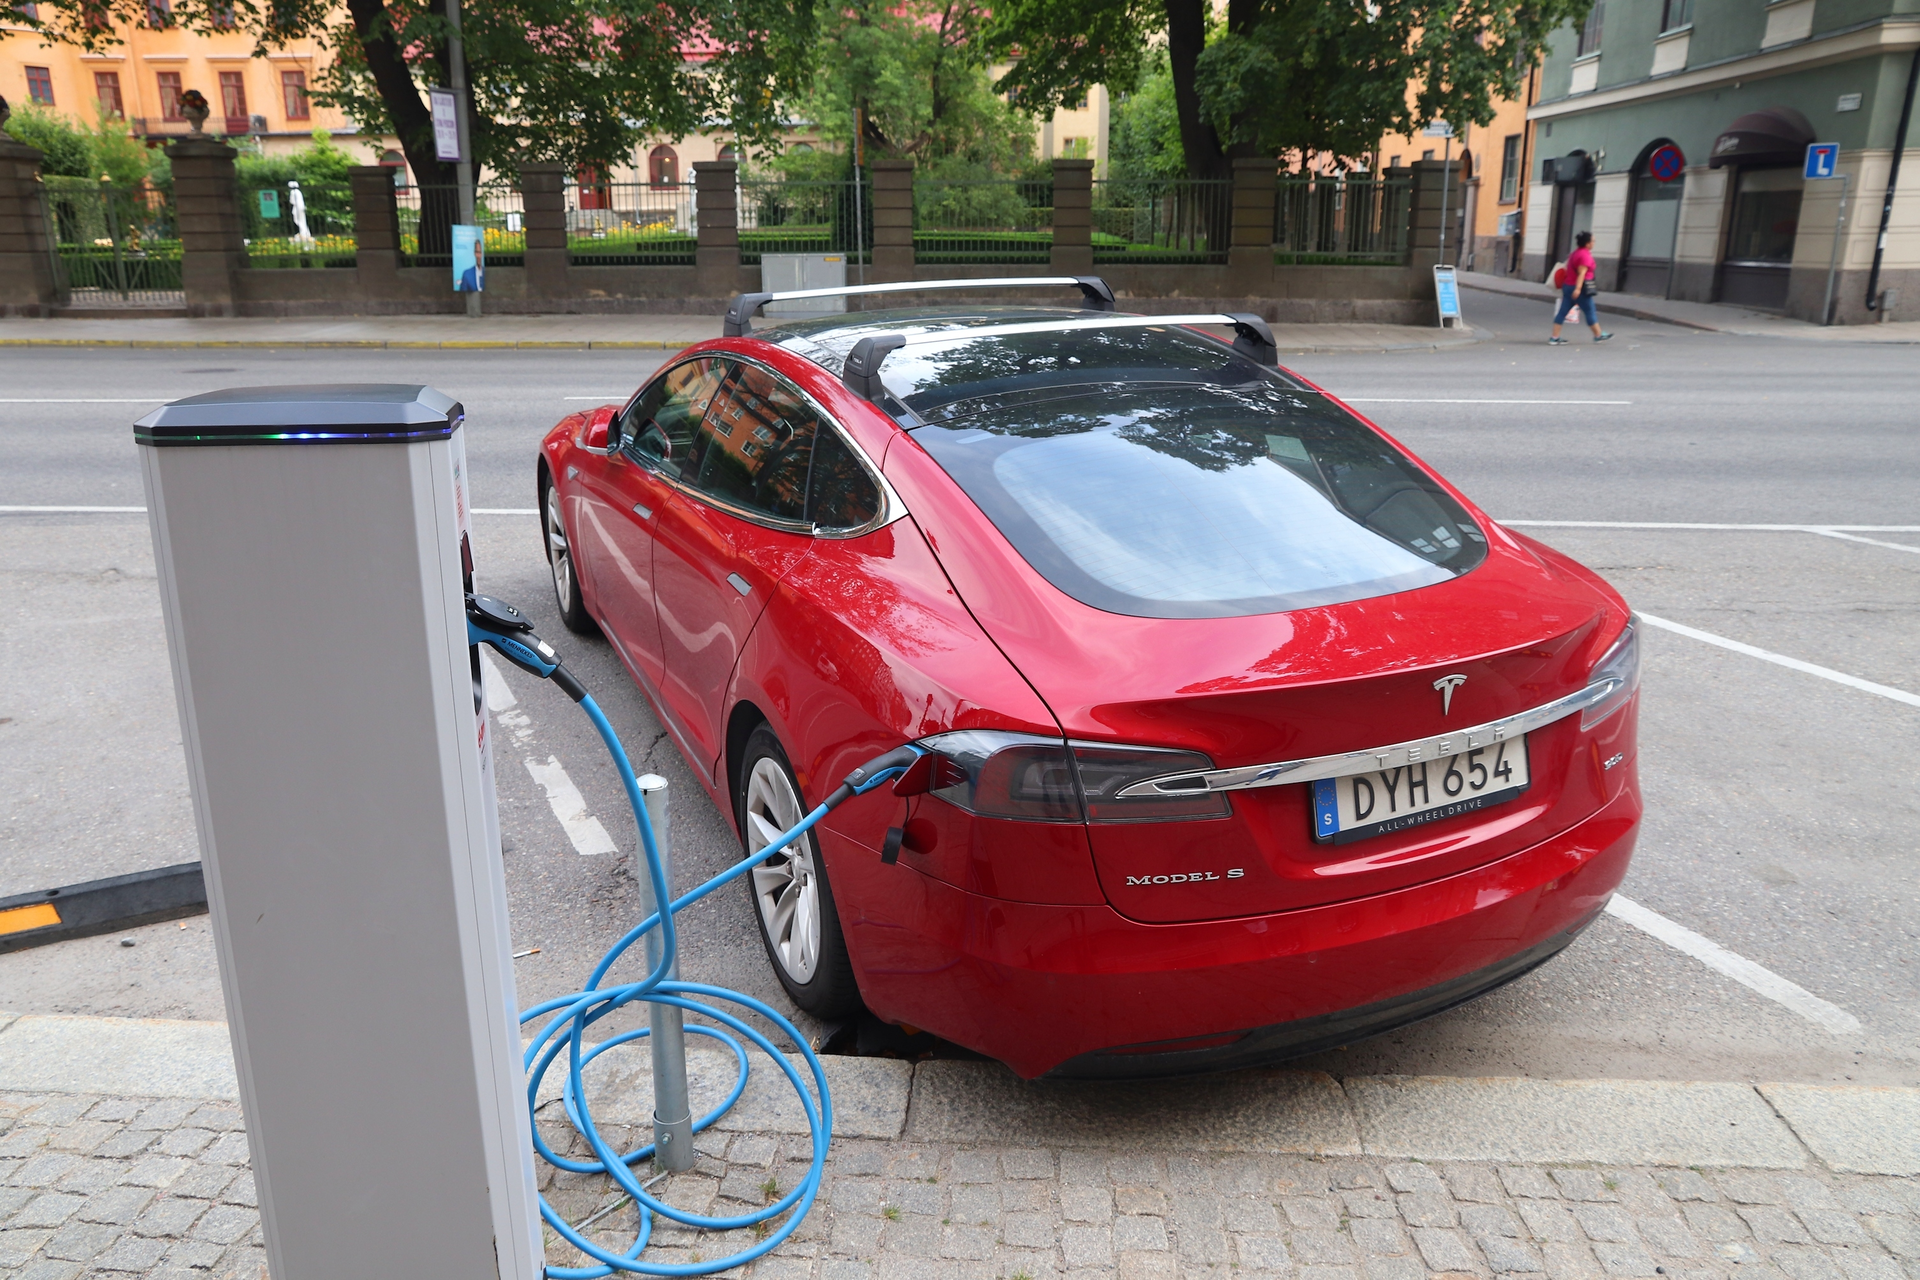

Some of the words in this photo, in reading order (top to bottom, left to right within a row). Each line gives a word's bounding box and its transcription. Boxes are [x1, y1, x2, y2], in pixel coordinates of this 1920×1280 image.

[1376, 726, 1505, 767] TESLA
[1352, 761, 1430, 821] DYH
[1442, 743, 1513, 796] 654
[1324, 813, 1332, 825] S
[1378, 810, 1445, 833] ALL-WHEEL
[1448, 799, 1482, 815] DRIVE
[1126, 872, 1220, 886] MODEL
[1227, 868, 1245, 879] S
